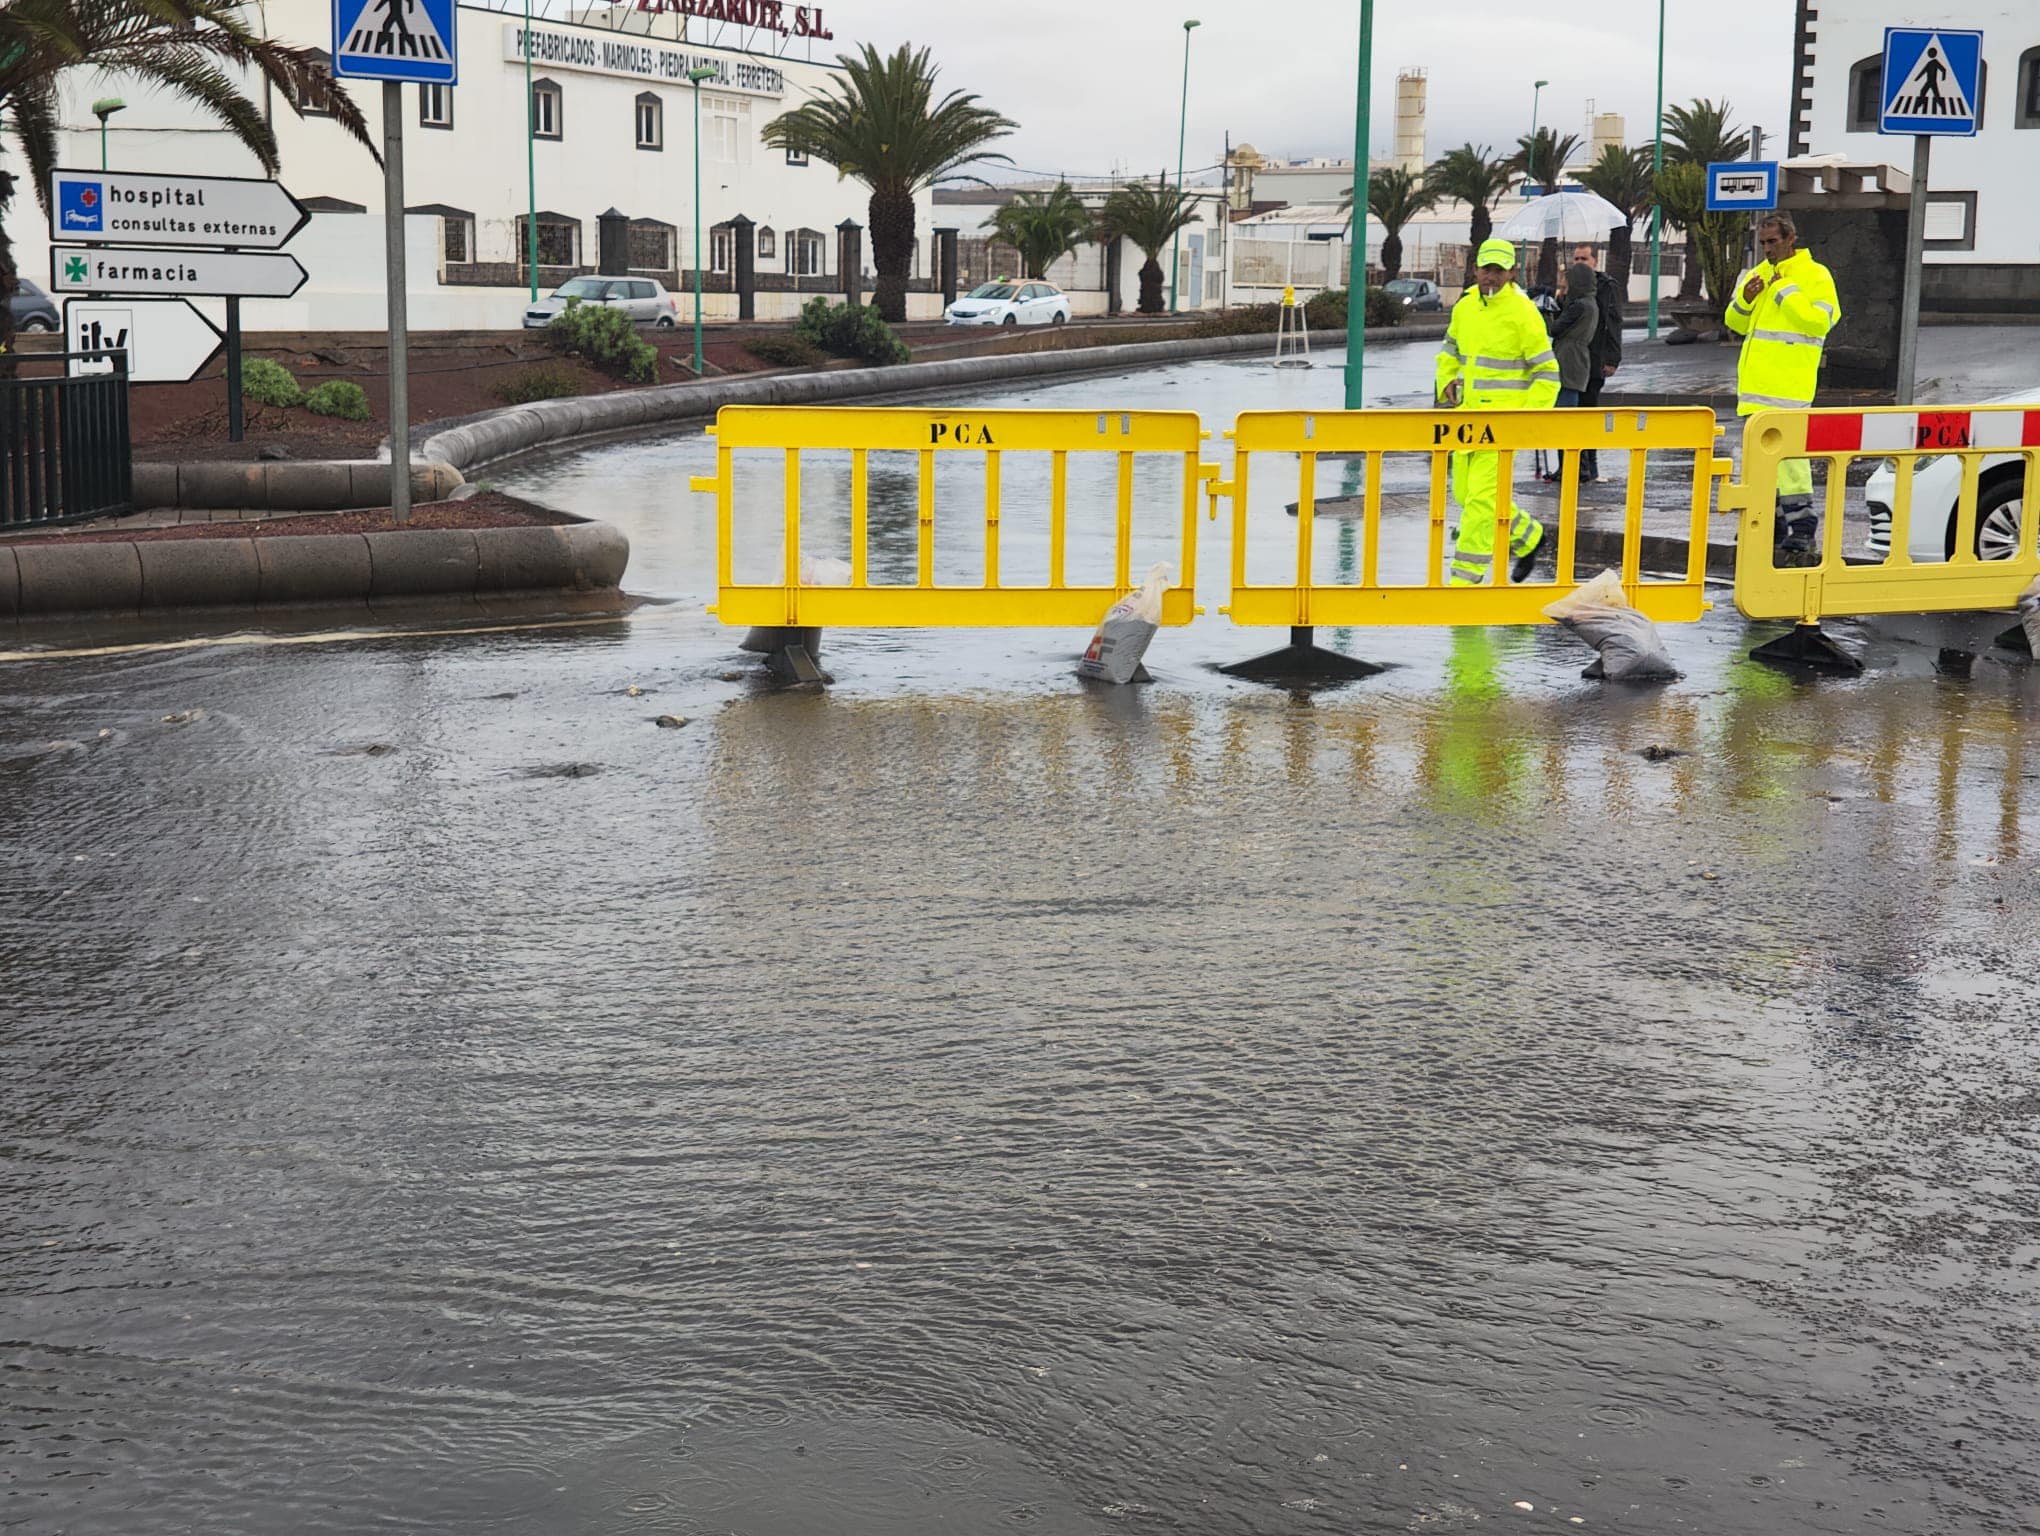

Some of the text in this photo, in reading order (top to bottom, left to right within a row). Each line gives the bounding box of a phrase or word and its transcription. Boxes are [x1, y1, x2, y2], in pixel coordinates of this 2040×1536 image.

[603, 42, 653, 74] MARMOLES
[659, 51, 689, 79] PIEDRA
[110, 185, 205, 207] hospital
[111, 218, 277, 236] consultas externas
[97, 262, 198, 282] farmacia
